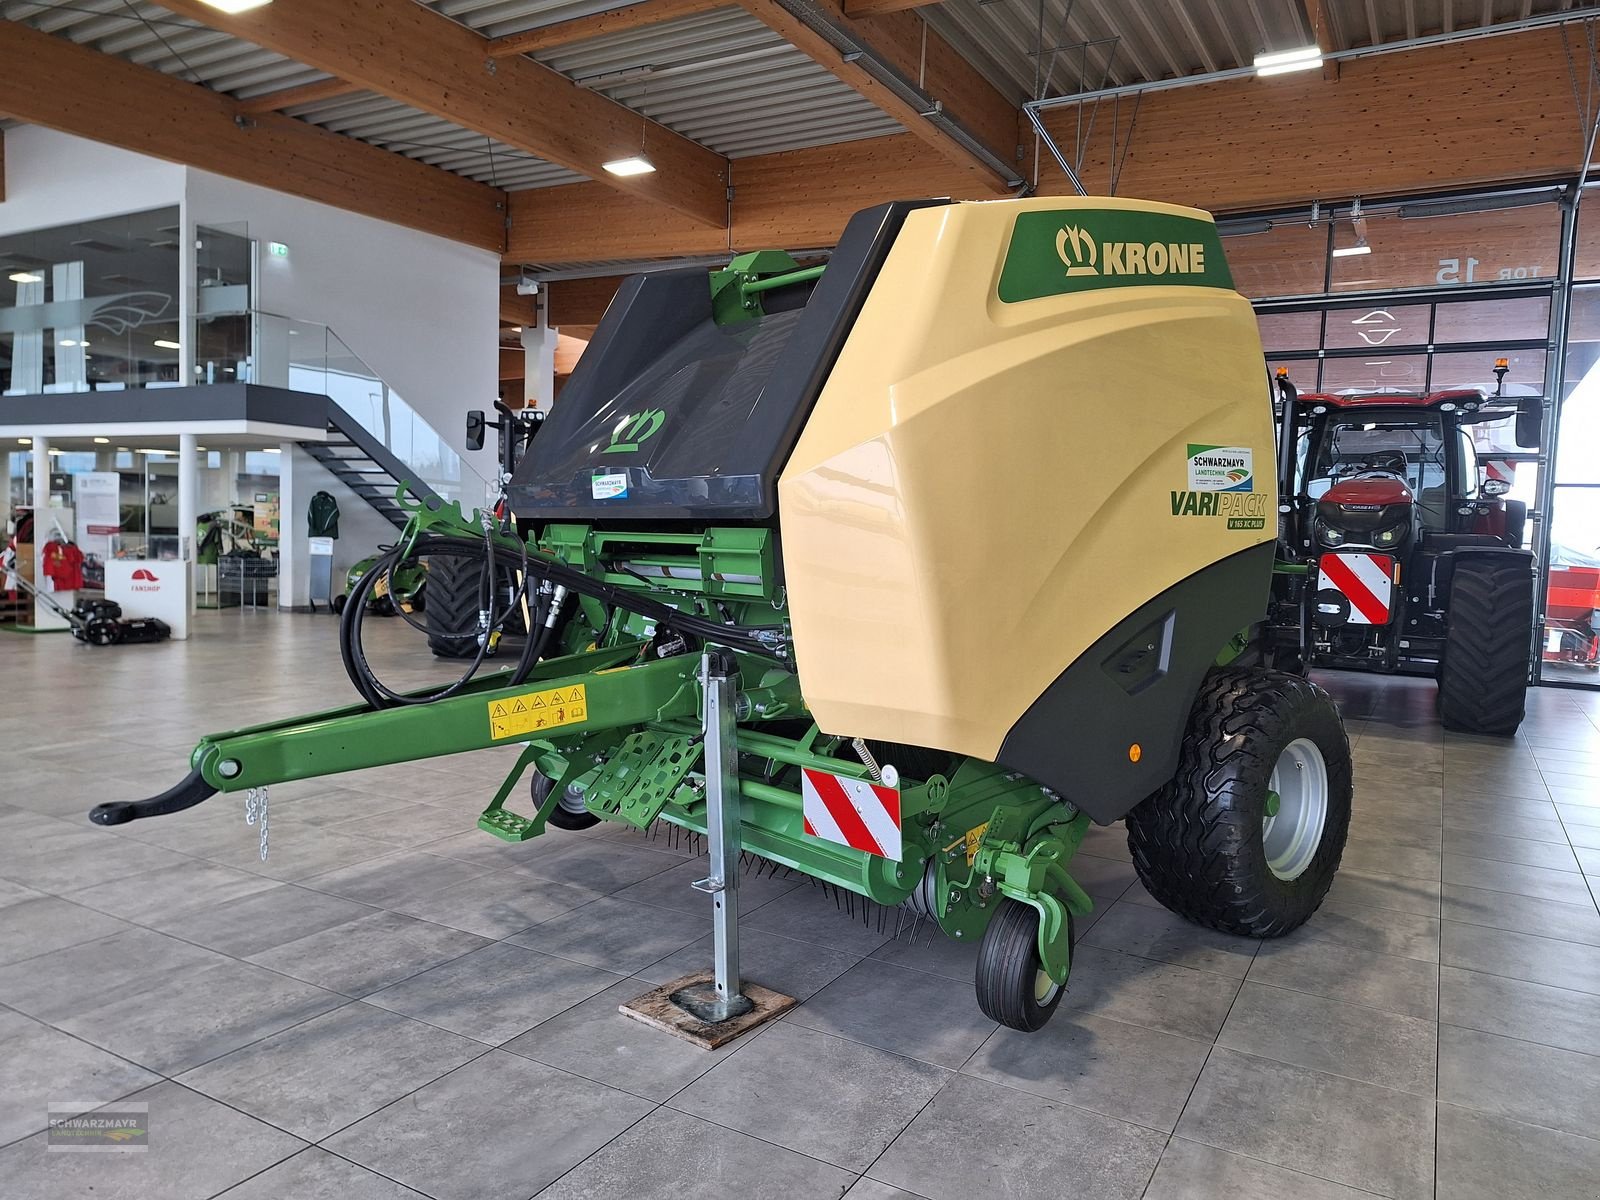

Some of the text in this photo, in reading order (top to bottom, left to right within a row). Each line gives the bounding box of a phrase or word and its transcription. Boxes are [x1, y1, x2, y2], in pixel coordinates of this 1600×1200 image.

[1103, 242, 1205, 275] KRONE
[1194, 456, 1245, 468] SCHWARZMAYR
[1171, 491, 1268, 516] VARIPACK
[1234, 519, 1244, 528] 165
[1251, 519, 1264, 528] PLUS
